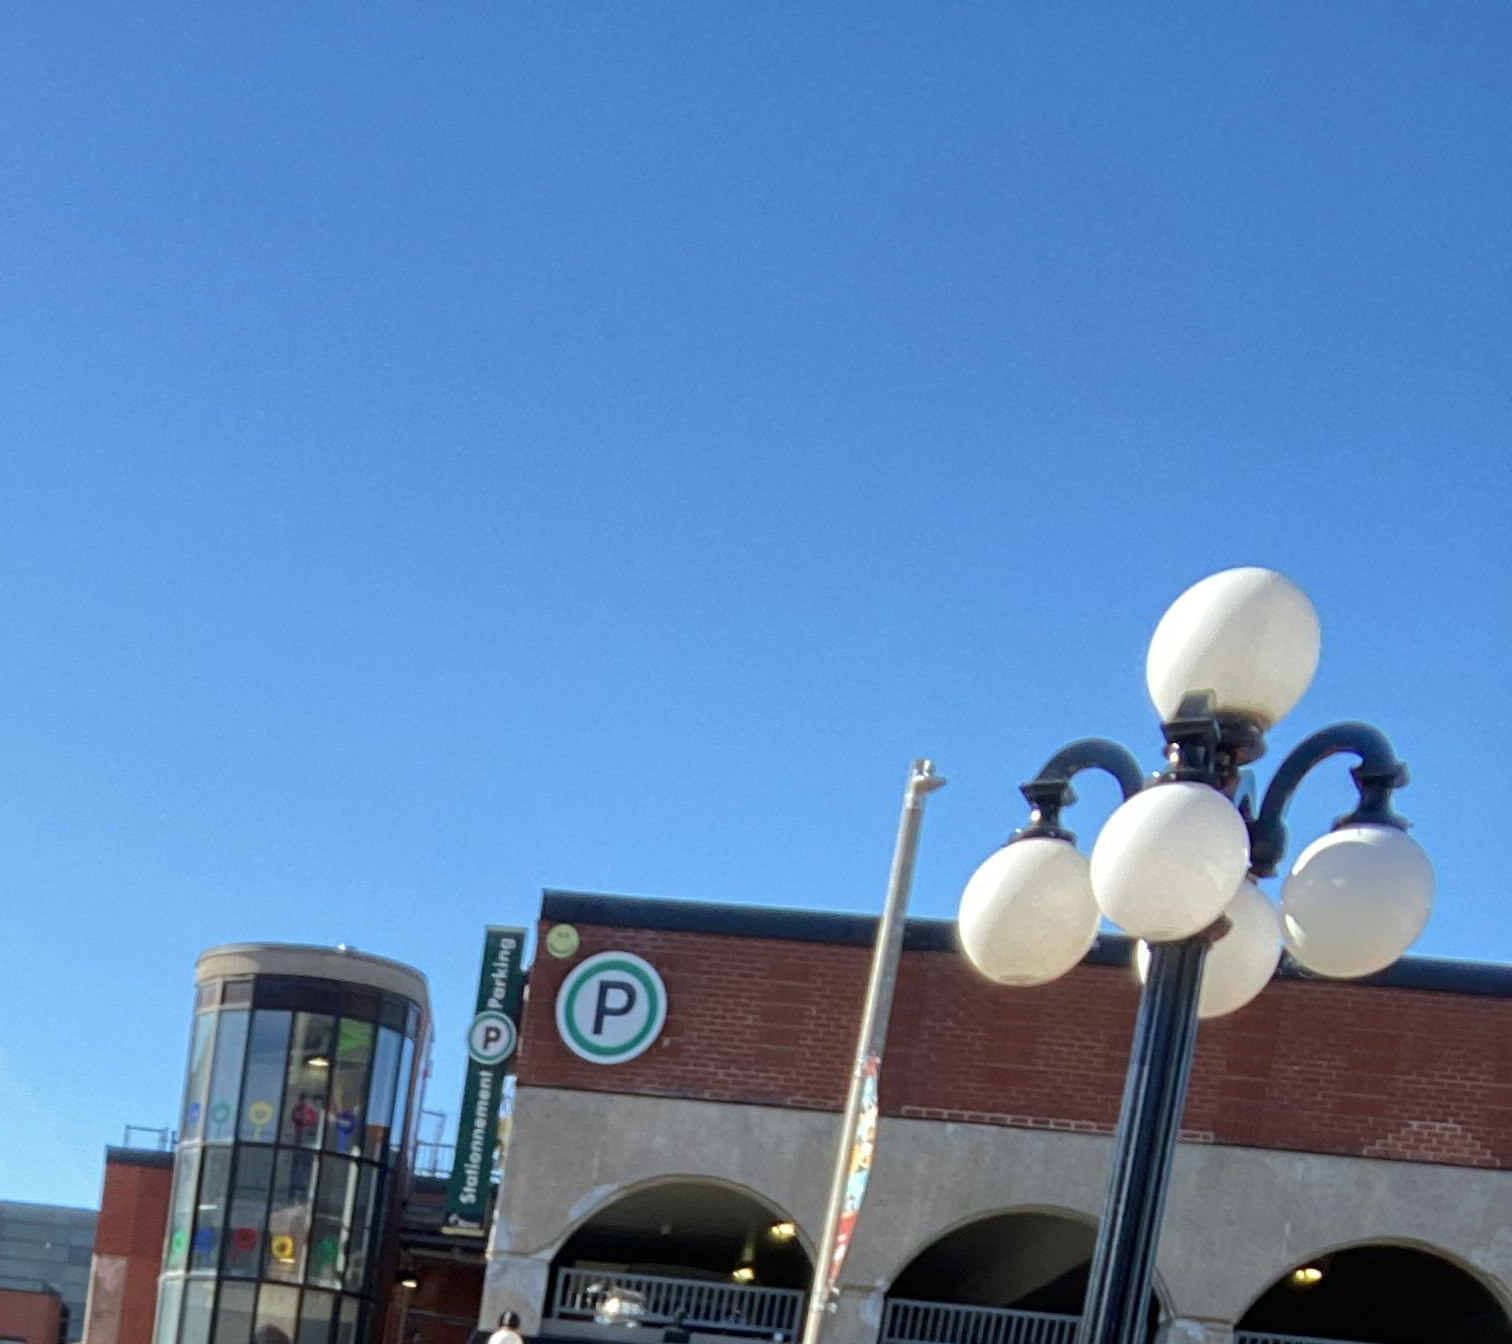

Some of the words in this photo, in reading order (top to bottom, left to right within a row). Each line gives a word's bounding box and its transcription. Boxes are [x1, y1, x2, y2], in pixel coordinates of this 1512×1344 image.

[487, 937, 517, 1010] Parking
[483, 1026, 501, 1050] P
[592, 979, 637, 1035] P
[459, 1070, 493, 1204] Stationnement
